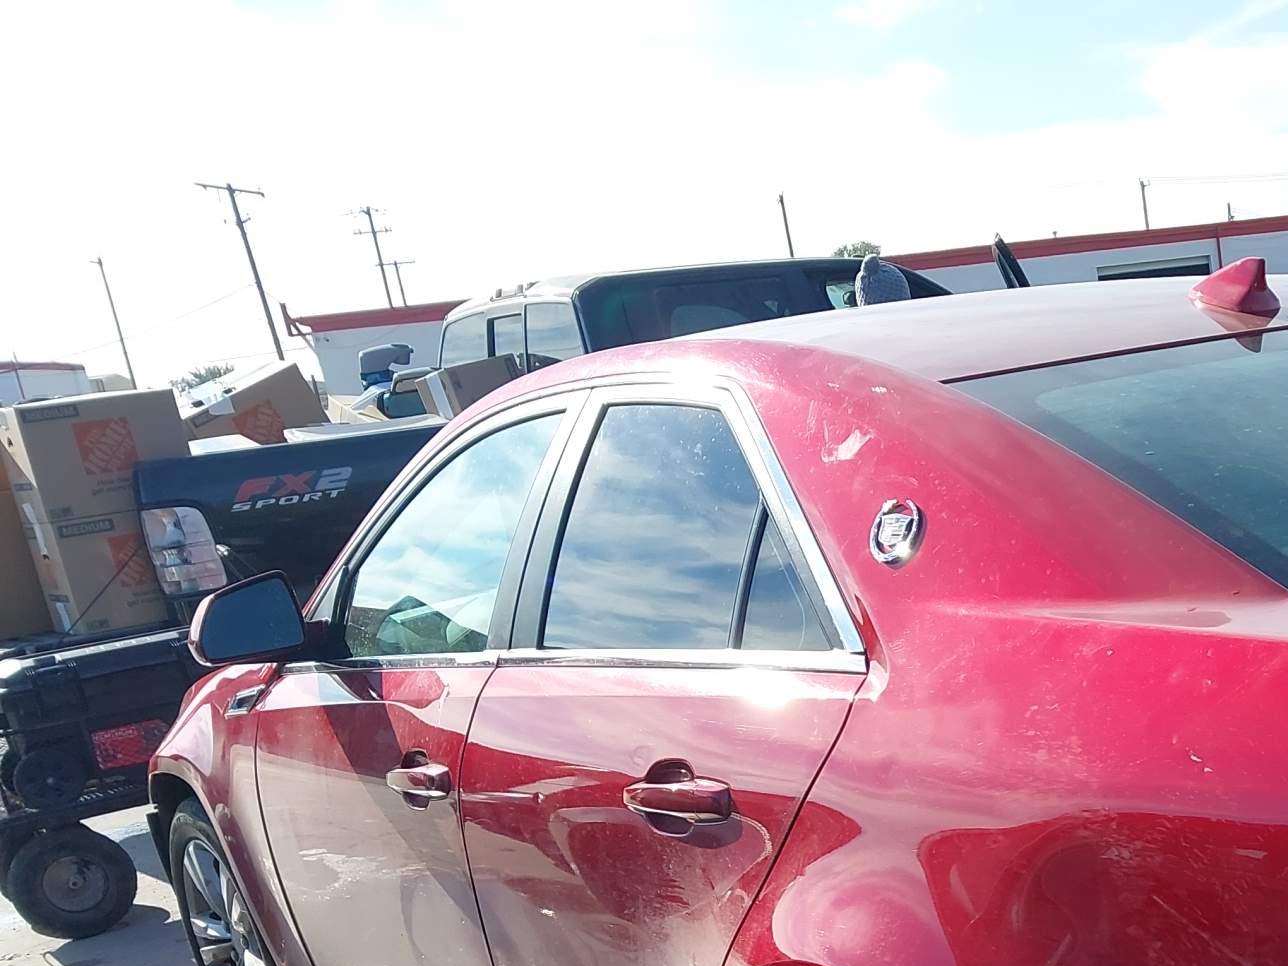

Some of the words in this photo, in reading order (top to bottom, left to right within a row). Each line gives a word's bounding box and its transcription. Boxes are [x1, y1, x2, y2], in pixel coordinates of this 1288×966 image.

[234, 466, 353, 503] FX2
[230, 488, 345, 513] SPORT
[63, 519, 111, 534] MEDIUM
